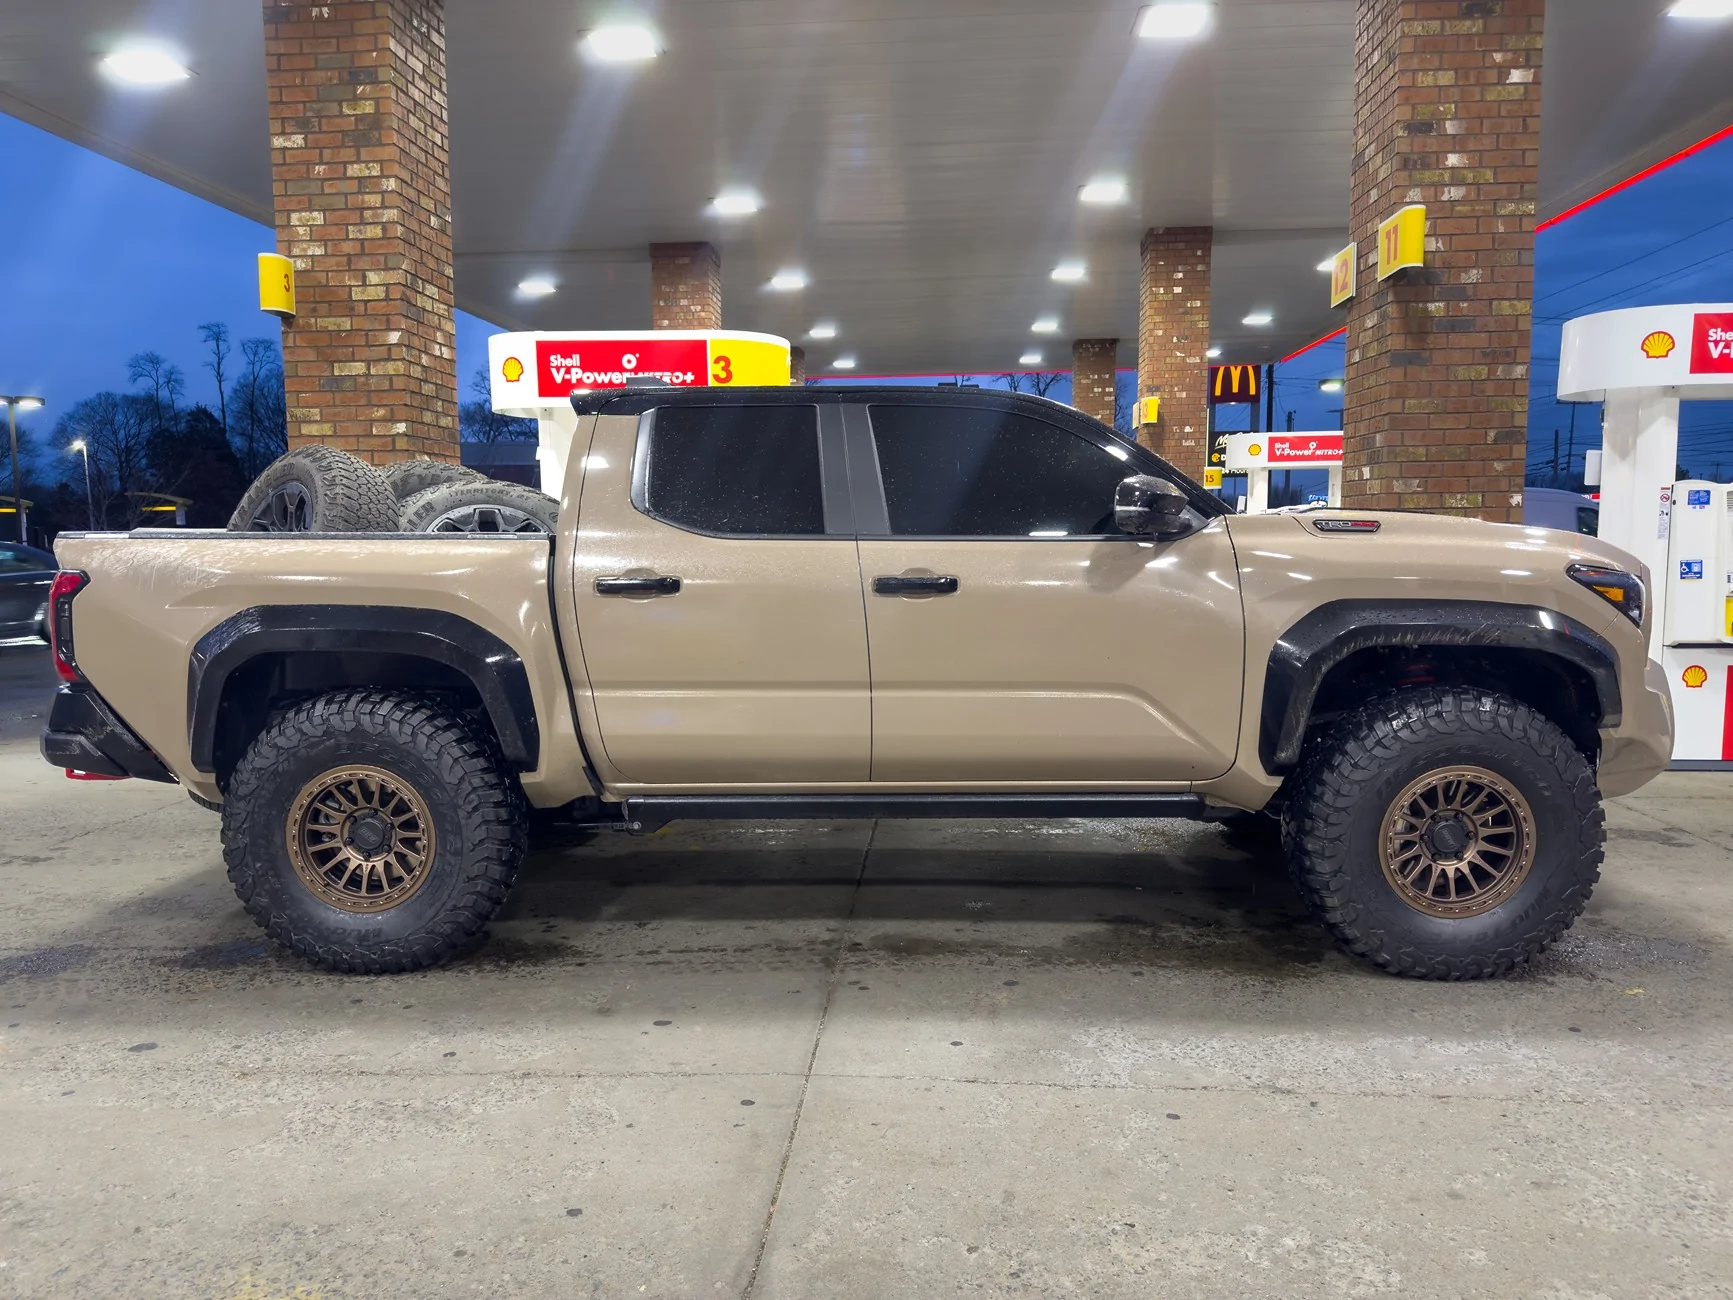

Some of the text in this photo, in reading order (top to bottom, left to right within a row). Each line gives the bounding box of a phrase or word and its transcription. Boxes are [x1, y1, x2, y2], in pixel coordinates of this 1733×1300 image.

[1385, 223, 1399, 266] 11
[283, 273, 291, 293] 3
[1334, 258, 1349, 296] 12
[549, 354, 580, 367] Shell
[550, 367, 634, 384] V-Power
[712, 355, 733, 384] 3
[1274, 448, 1314, 456] V-Power
[1205, 475, 1215, 483] 15
[1316, 520, 1351, 528] TRD
